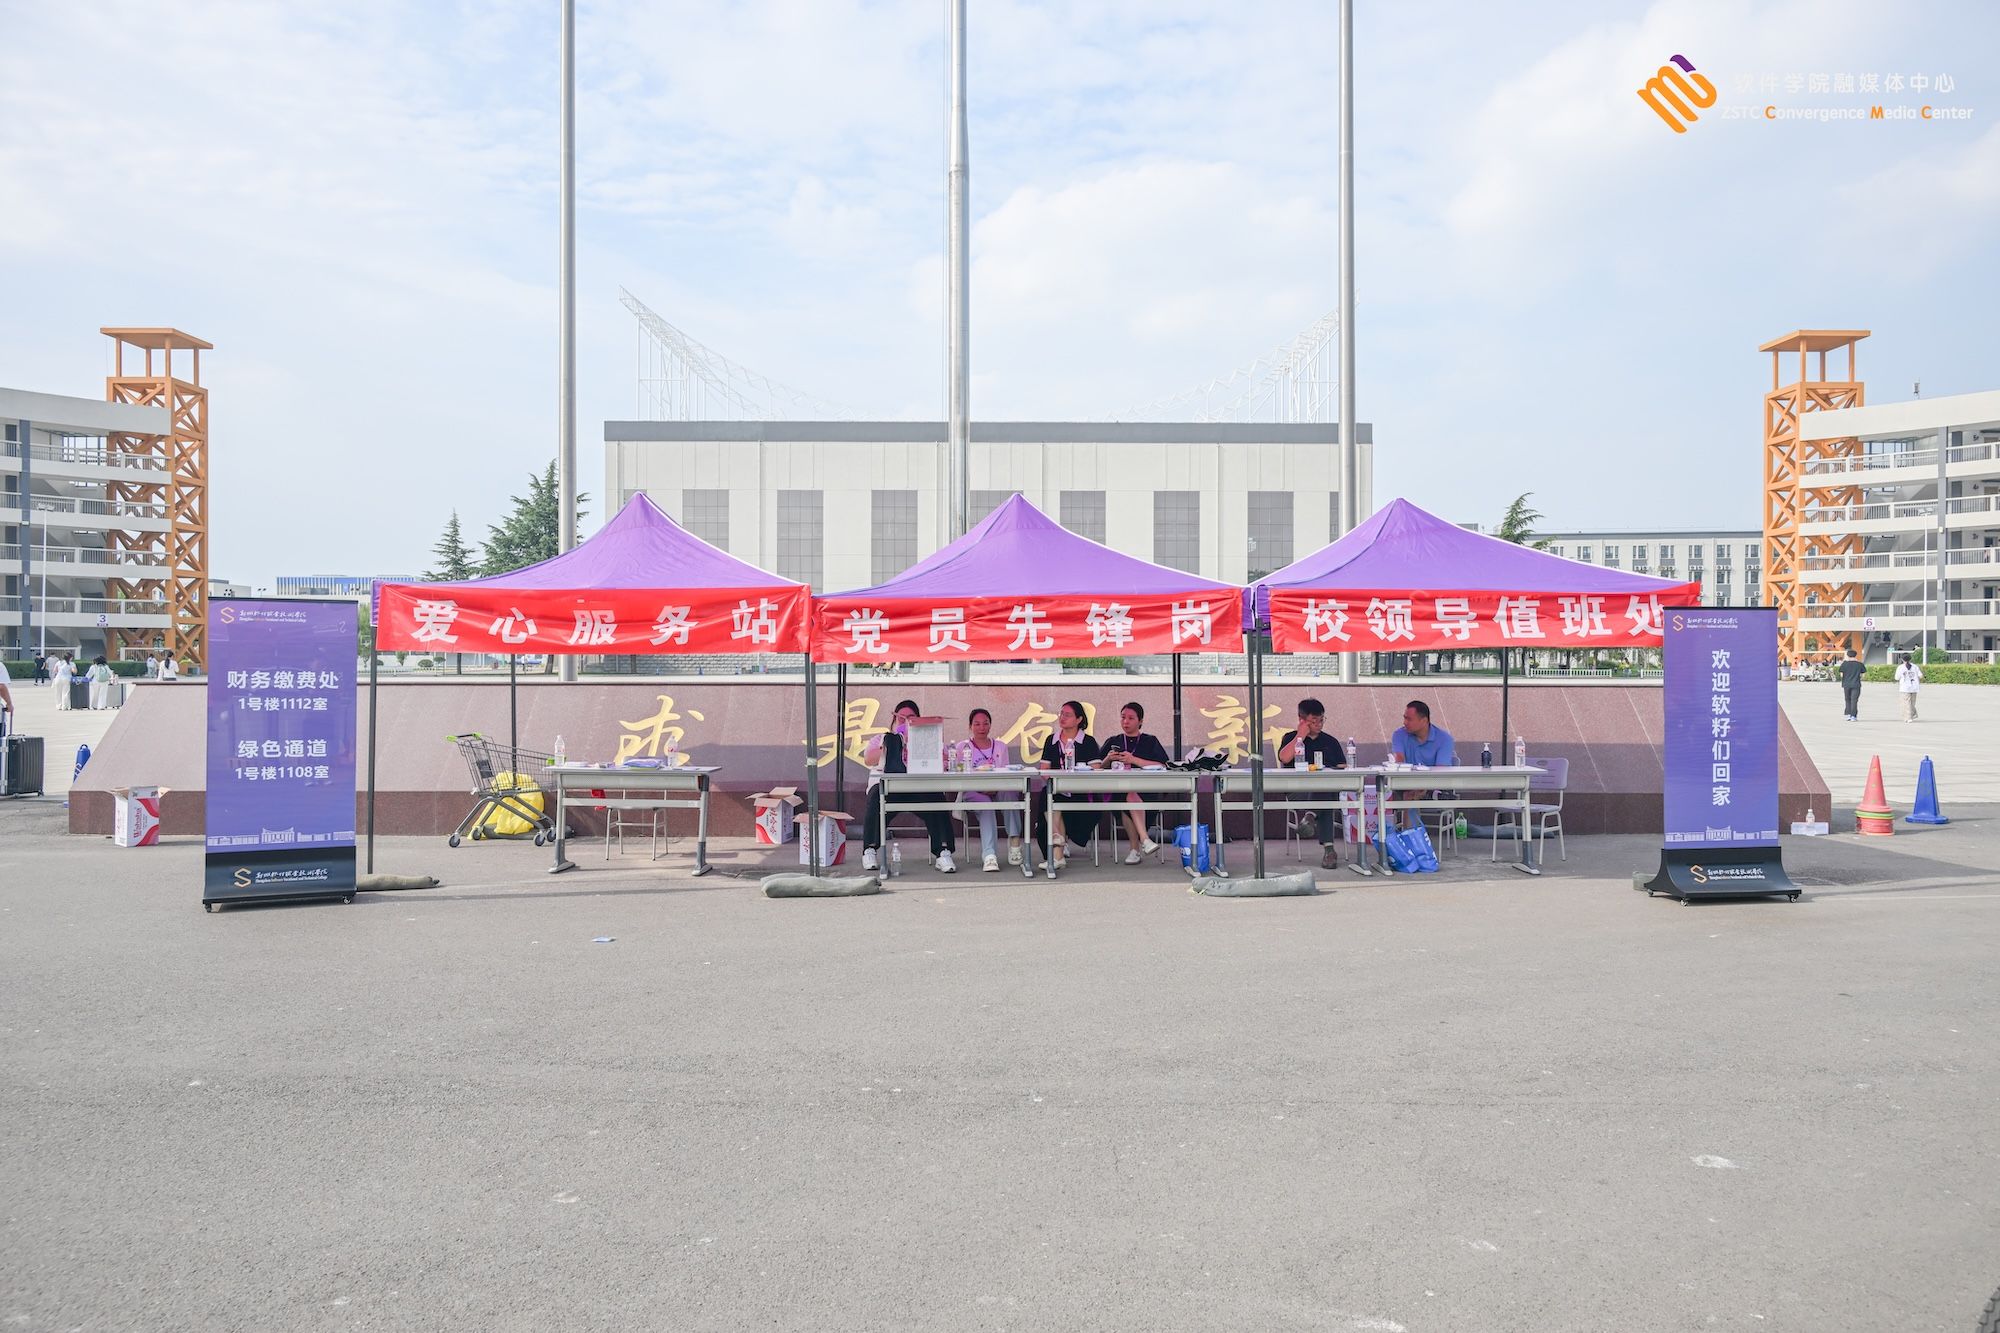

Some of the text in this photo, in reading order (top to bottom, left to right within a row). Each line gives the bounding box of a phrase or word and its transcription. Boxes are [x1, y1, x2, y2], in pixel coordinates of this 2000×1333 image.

[100, 615, 106, 623] 3
[411, 598, 779, 646] 爱心服务站
[843, 599, 1212, 654] 党员先锋岗
[1302, 593, 1664, 643] 校领导值班处
[1866, 618, 1873, 627] 6
[227, 670, 339, 690] 财务缴费处
[238, 697, 328, 711] 1号楼1112室
[1712, 649, 1731, 806] 欢迎软籽们回家
[237, 739, 328, 758] 绿色通道
[235, 765, 329, 780] 1号楼1108室
